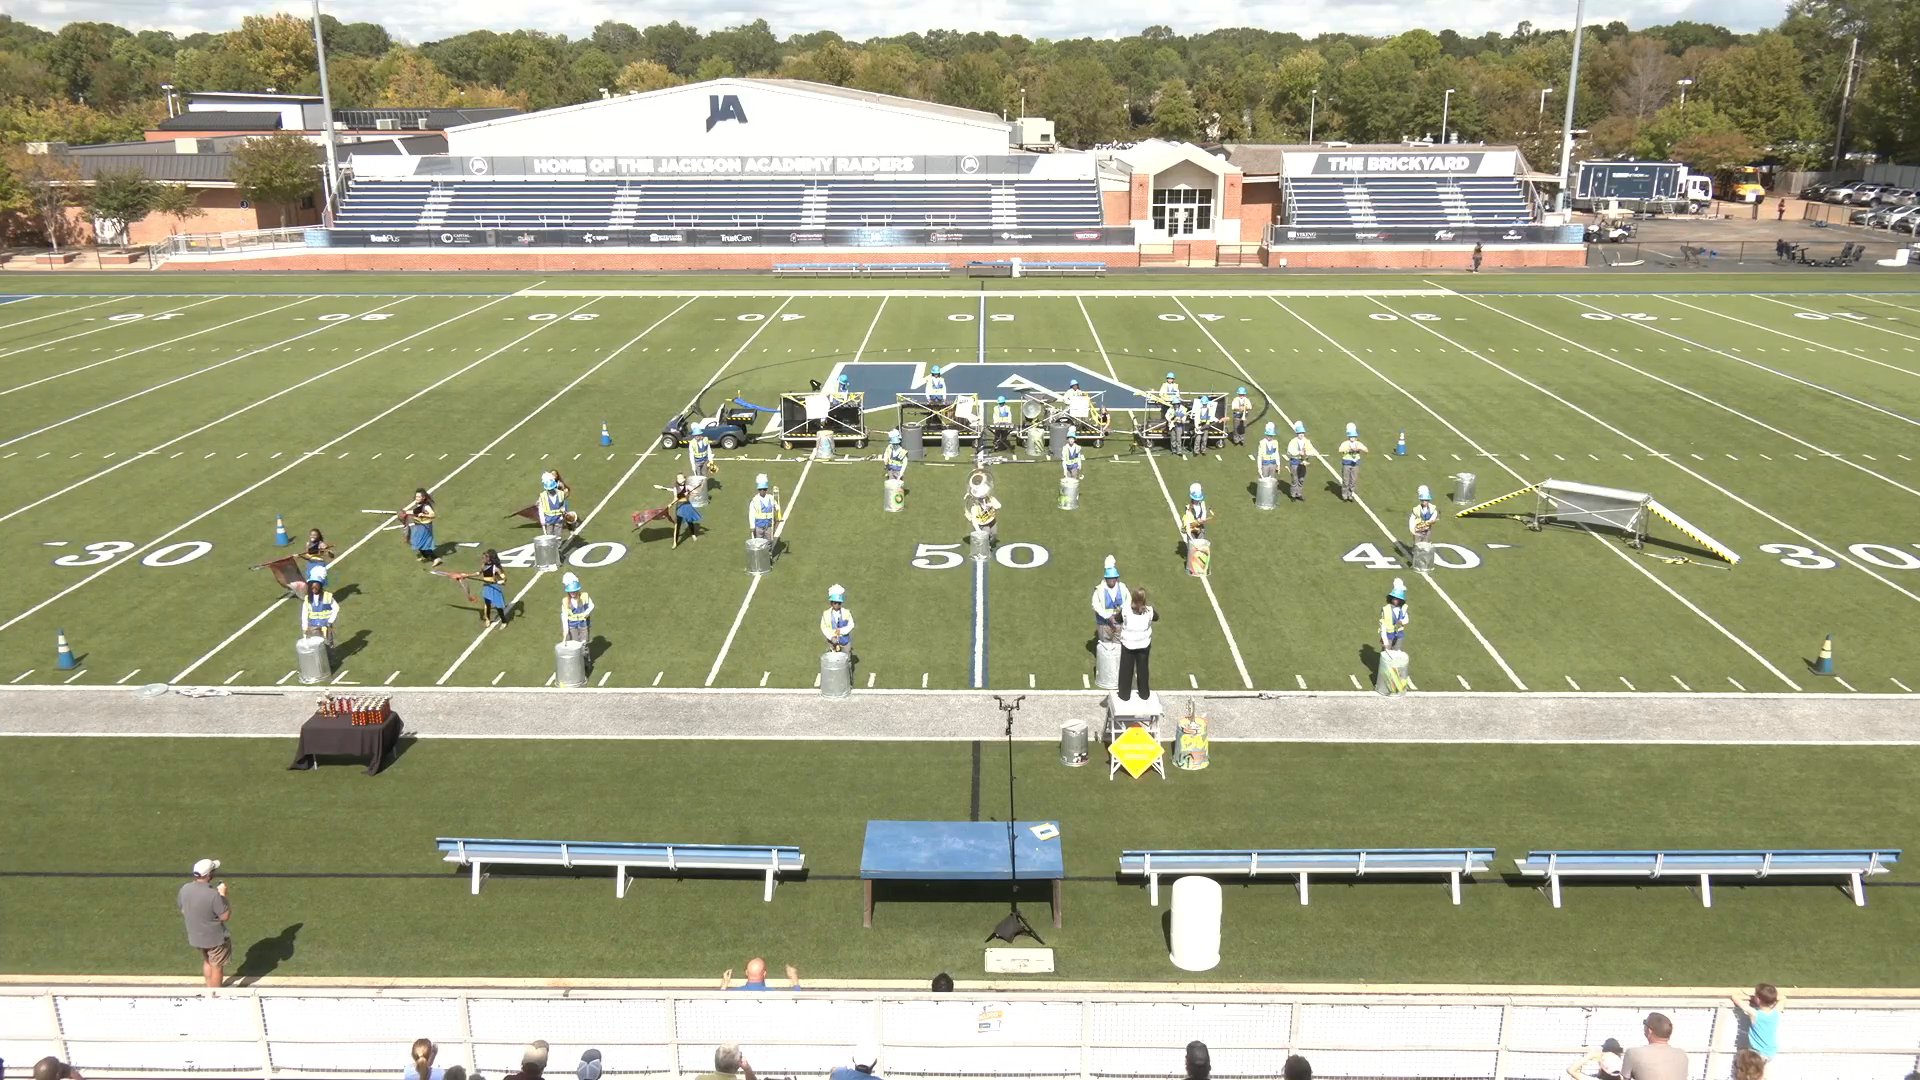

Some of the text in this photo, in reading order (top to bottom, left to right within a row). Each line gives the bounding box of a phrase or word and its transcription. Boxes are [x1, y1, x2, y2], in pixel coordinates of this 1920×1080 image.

[705, 94, 748, 132] JA
[533, 157, 914, 173] HOME OF THE JACKSON ACADEMY RAIDERS
[1327, 157, 1470, 171] THE BRICKYARD
[720, 234, 752, 242] TrustCare
[52, 541, 214, 567] 30
[911, 542, 1050, 570] 50
